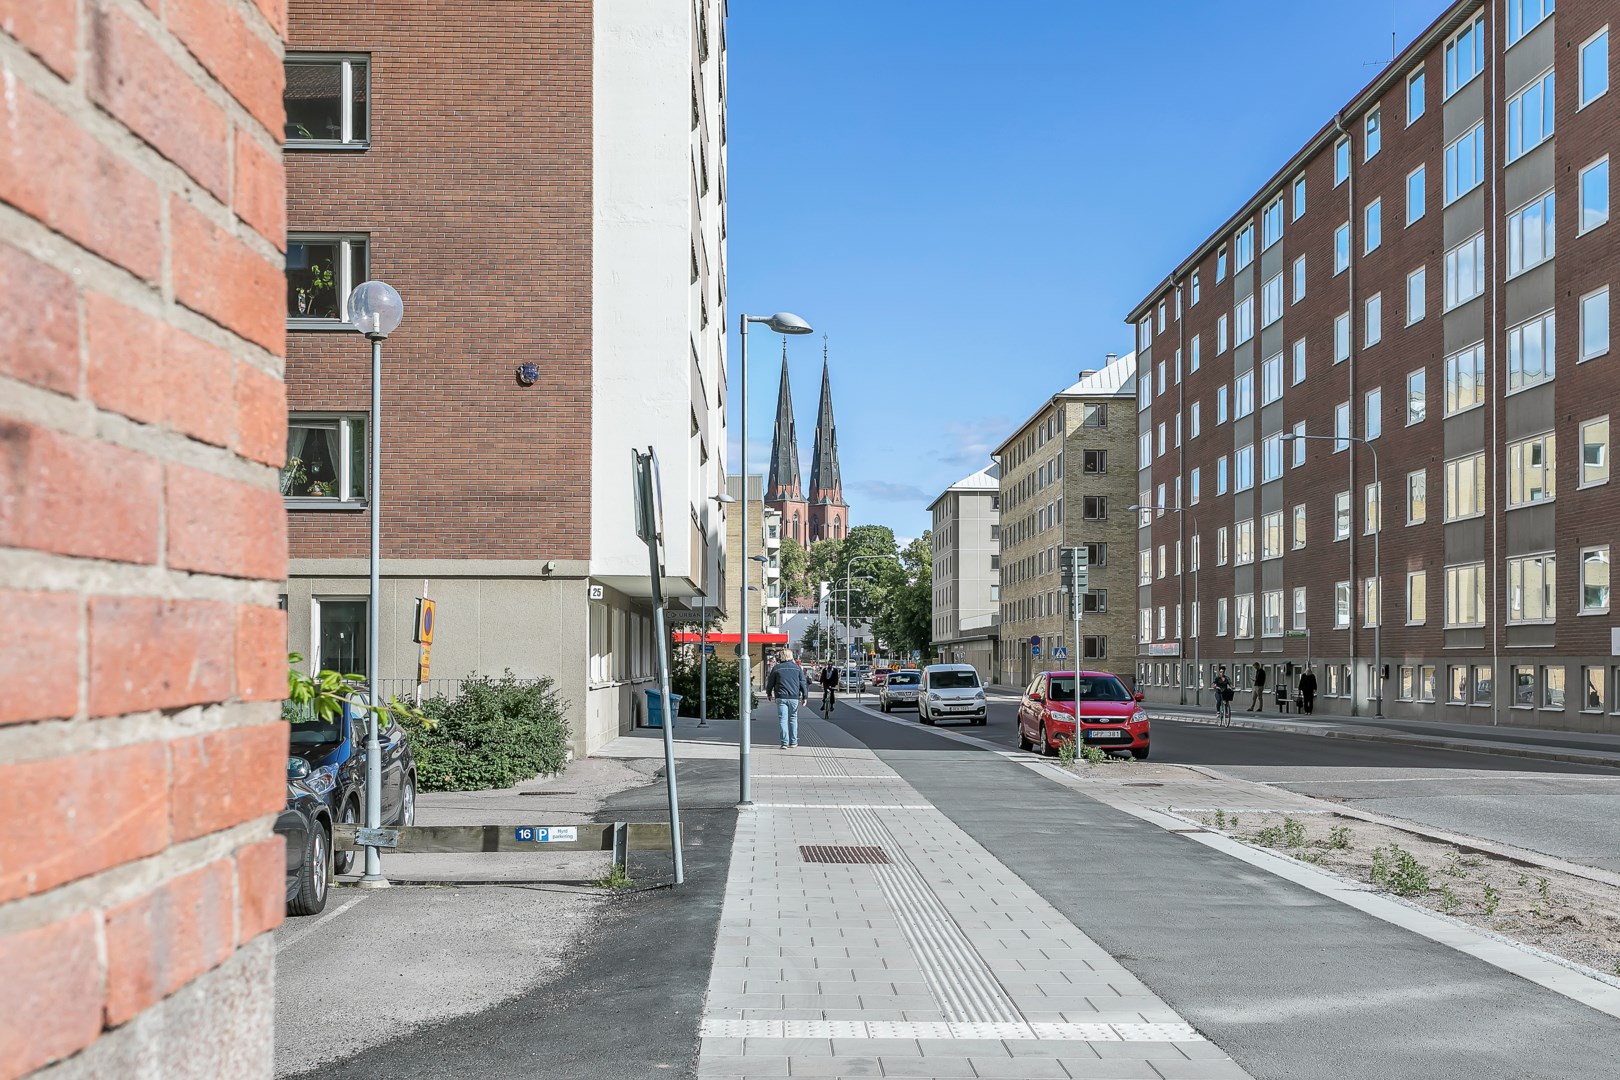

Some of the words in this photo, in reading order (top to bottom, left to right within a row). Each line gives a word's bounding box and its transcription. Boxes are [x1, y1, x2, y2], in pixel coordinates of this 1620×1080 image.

[592, 588, 602, 596] 25
[518, 829, 532, 839] 16
[540, 829, 548, 840] P
